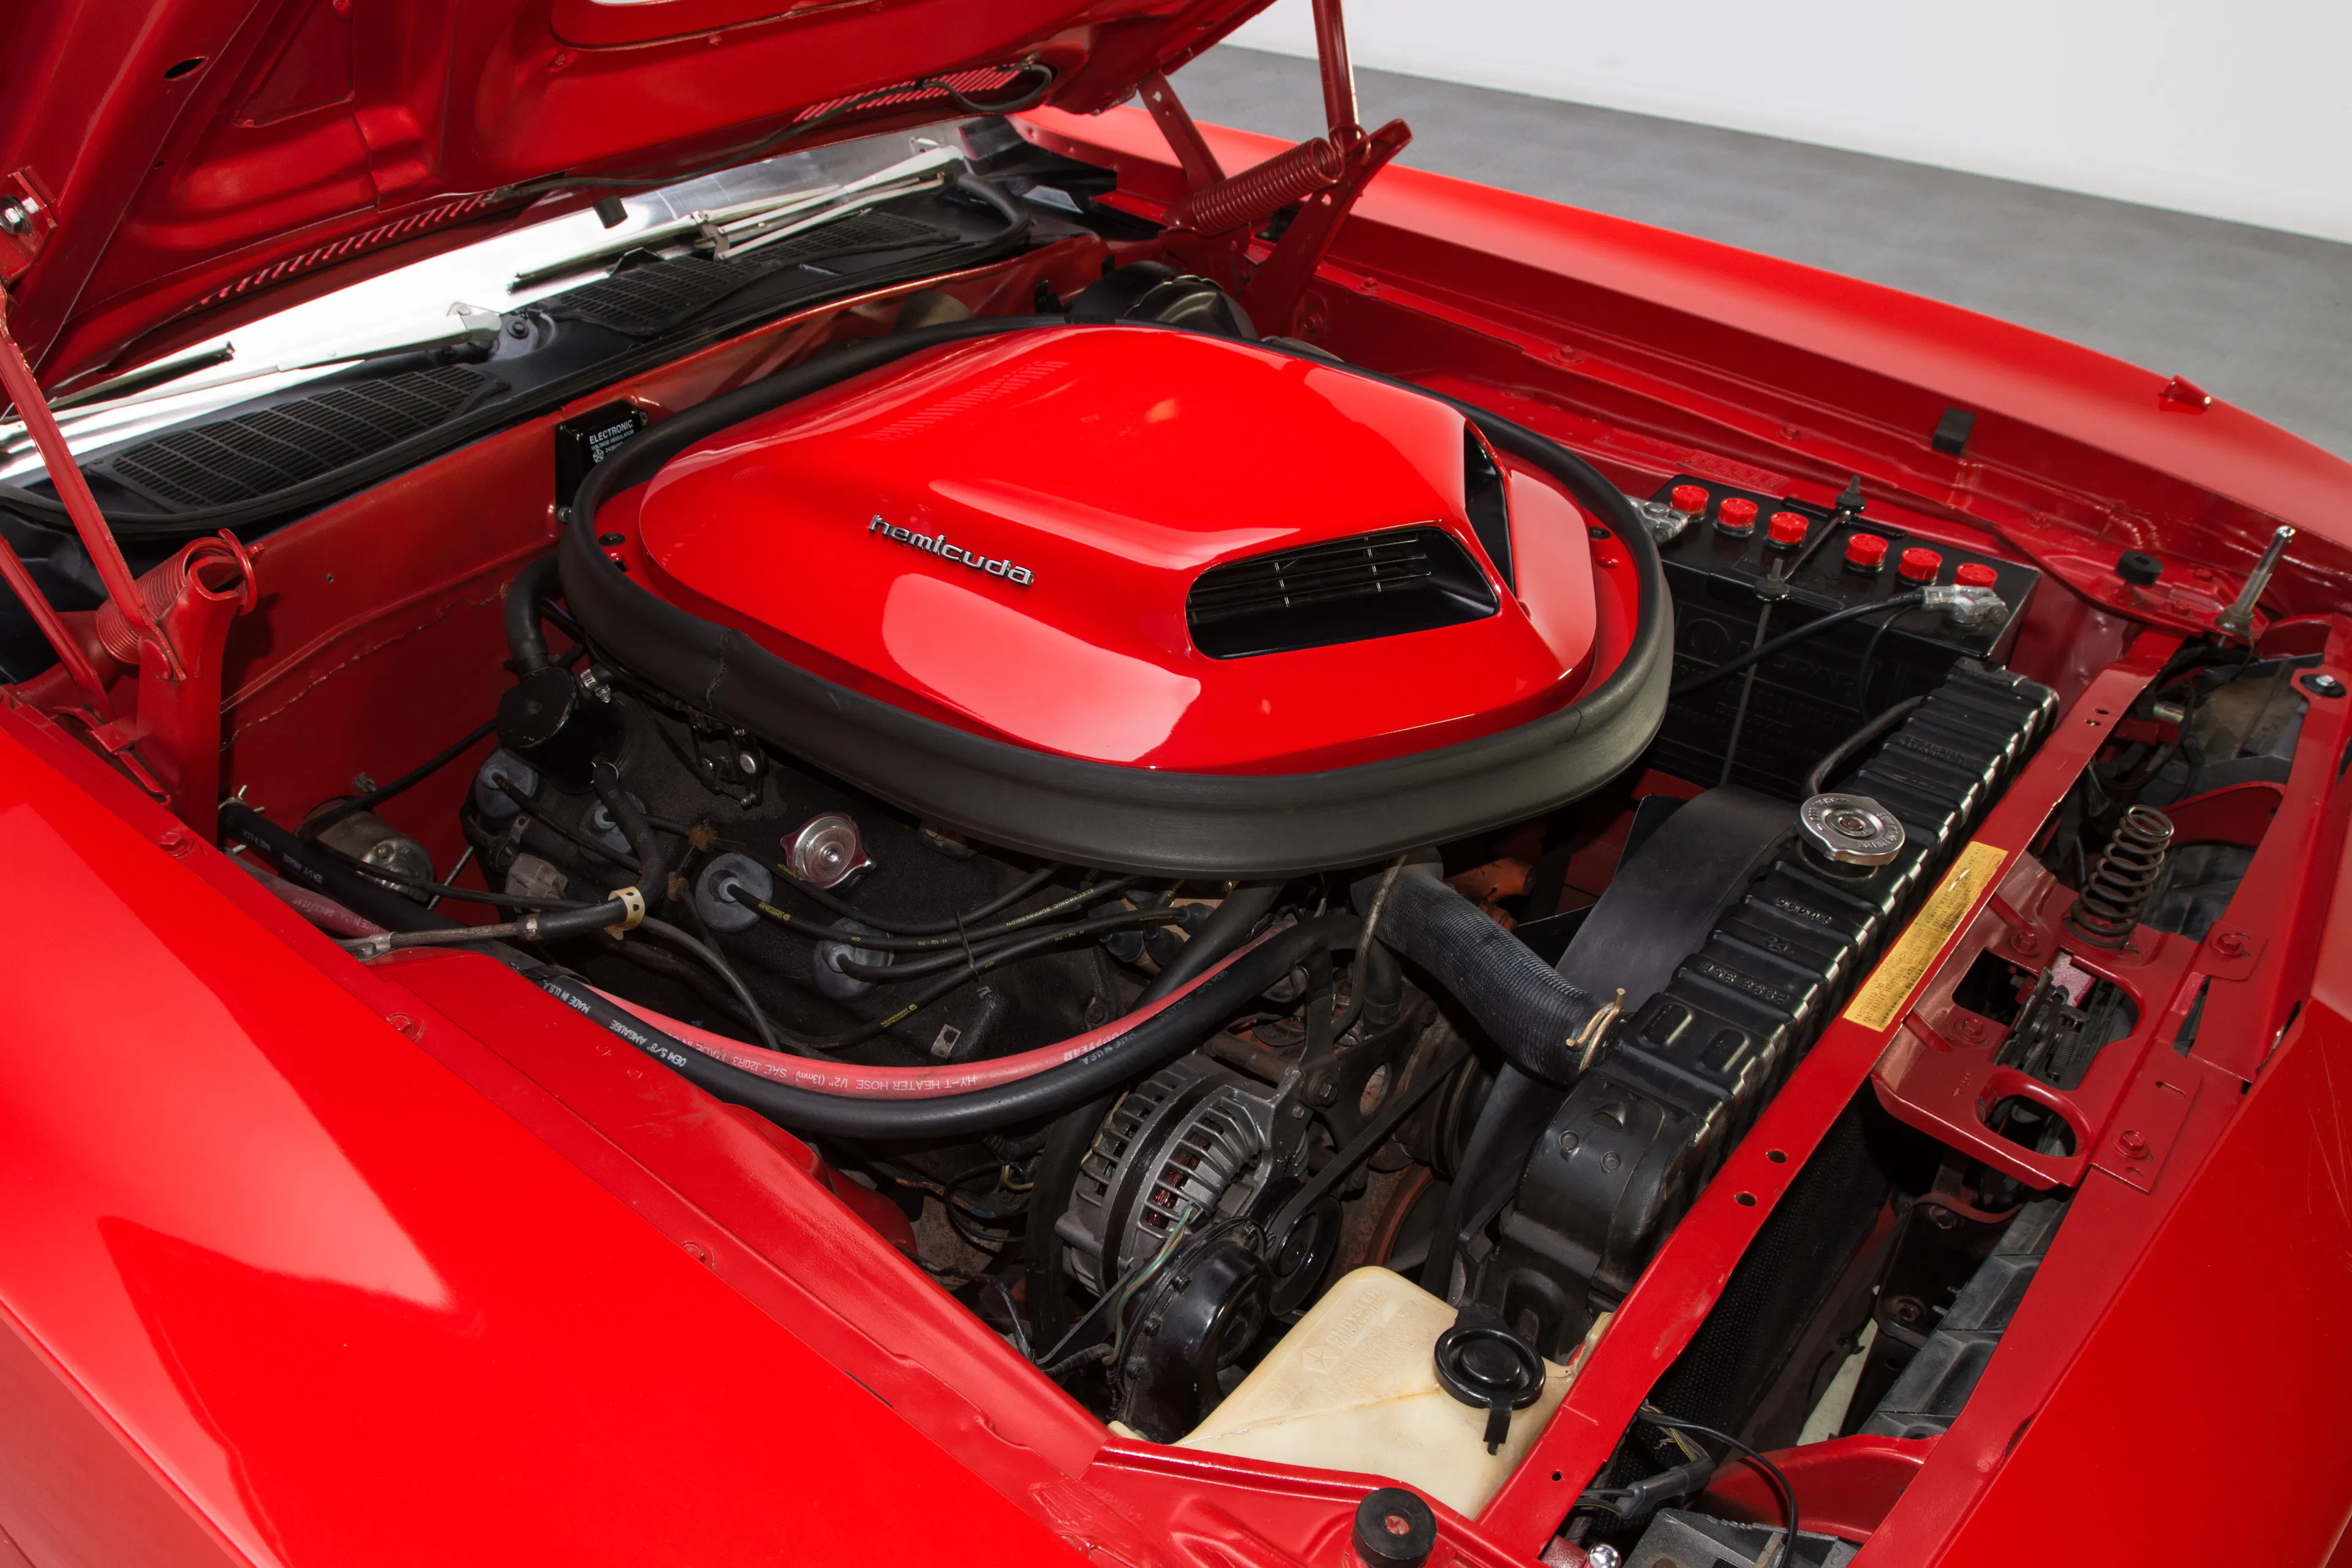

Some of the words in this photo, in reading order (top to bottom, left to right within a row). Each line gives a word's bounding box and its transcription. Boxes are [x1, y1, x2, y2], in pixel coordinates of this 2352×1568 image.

[589, 419, 633, 444] ELECTRONIC
[590, 440, 609, 450] VOLTAGE
[610, 429, 634, 444] REGULATOR
[869, 514, 1034, 587] hemicuda
[1052, 888, 1094, 909] ELECTRONIC
[1945, 888, 1962, 909] AMOUNT
[1005, 905, 1050, 928] SUPPRESSION
[1924, 904, 1942, 924] ALWAYS
[1902, 963, 1917, 981] DATE
[560, 990, 568, 1002] IN
[568, 995, 591, 1014] MADE
[1853, 990, 1879, 1021] PROTECTED
[1875, 981, 1885, 992] TO
[1862, 992, 1887, 1023] ANTIFREEZE
[609, 1020, 648, 1046] AMGAUGE
[667, 1055, 687, 1068] OEM
[696, 1043, 726, 1062] MADE
[732, 1056, 763, 1072] J20R3
[763, 1065, 786, 1079] SAE
[796, 1069, 825, 1087] (13mm)
[856, 1077, 889, 1091] HOSE
[892, 1077, 940, 1092] HEATER
[1325, 1287, 1381, 1346] CHRYSLER
